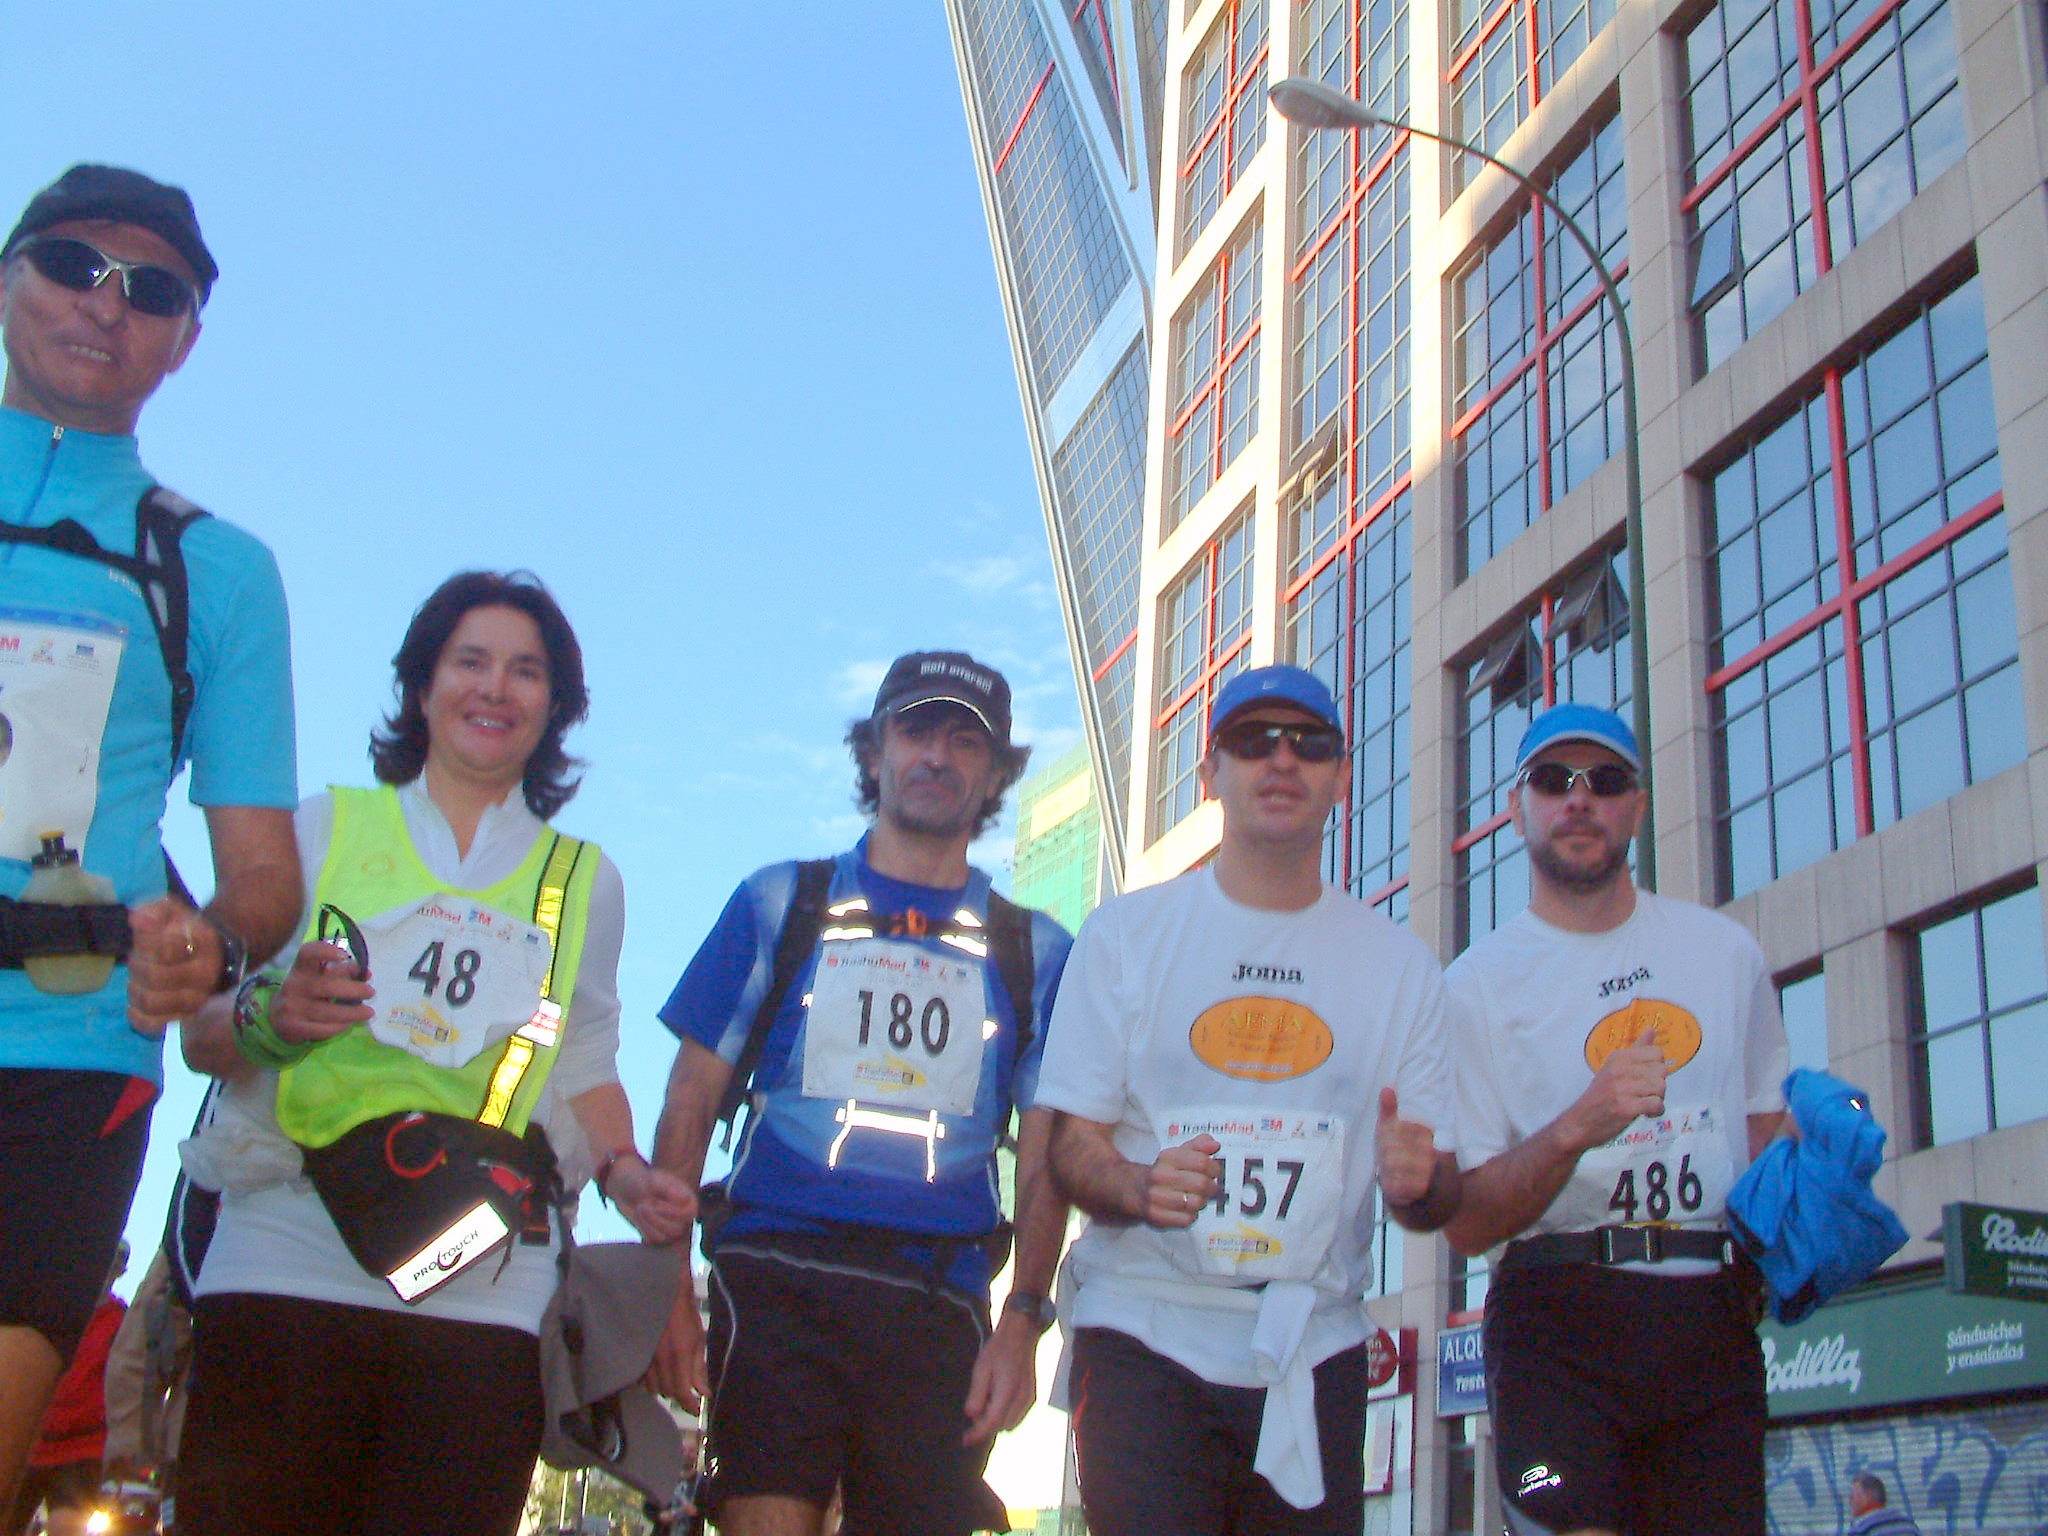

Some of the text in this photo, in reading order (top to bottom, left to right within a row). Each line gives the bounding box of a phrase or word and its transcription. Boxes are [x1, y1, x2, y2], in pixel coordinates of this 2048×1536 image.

[408, 941, 481, 1010] 48
[858, 989, 950, 1056] 180
[1608, 1153, 1704, 1222] 486
[412, 1228, 480, 1282] PRO TOUCH
